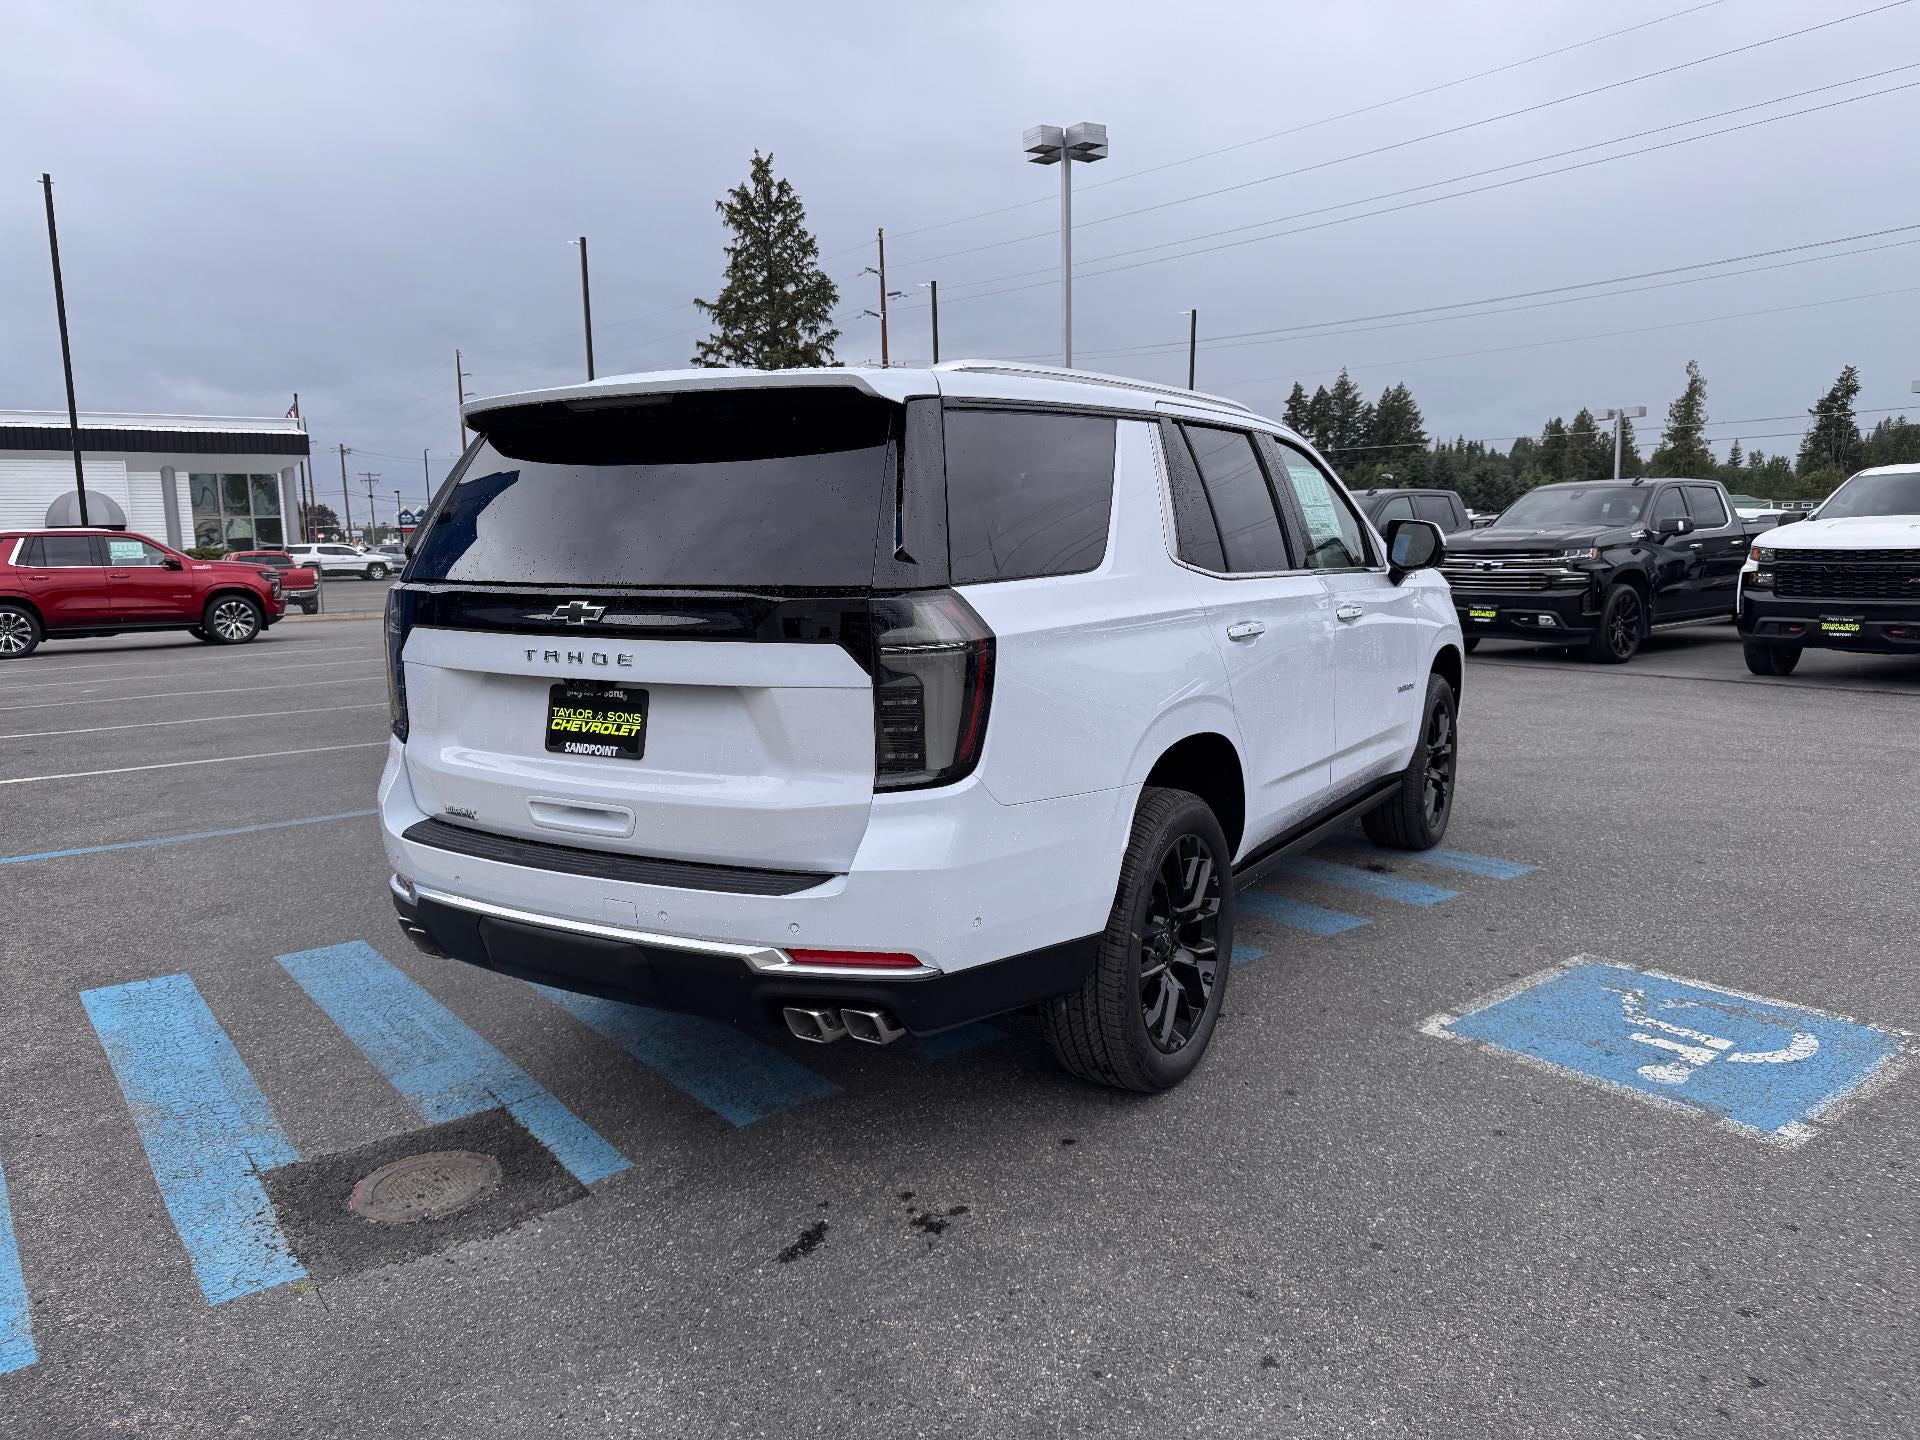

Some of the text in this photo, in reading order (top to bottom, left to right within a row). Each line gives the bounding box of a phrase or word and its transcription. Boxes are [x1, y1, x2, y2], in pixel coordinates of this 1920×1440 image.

[524, 649, 634, 667] TAHOE
[552, 707, 642, 723] TAYLOR & SONS
[551, 719, 641, 736] CHEVROLET
[564, 741, 619, 757] SANDPOINT
